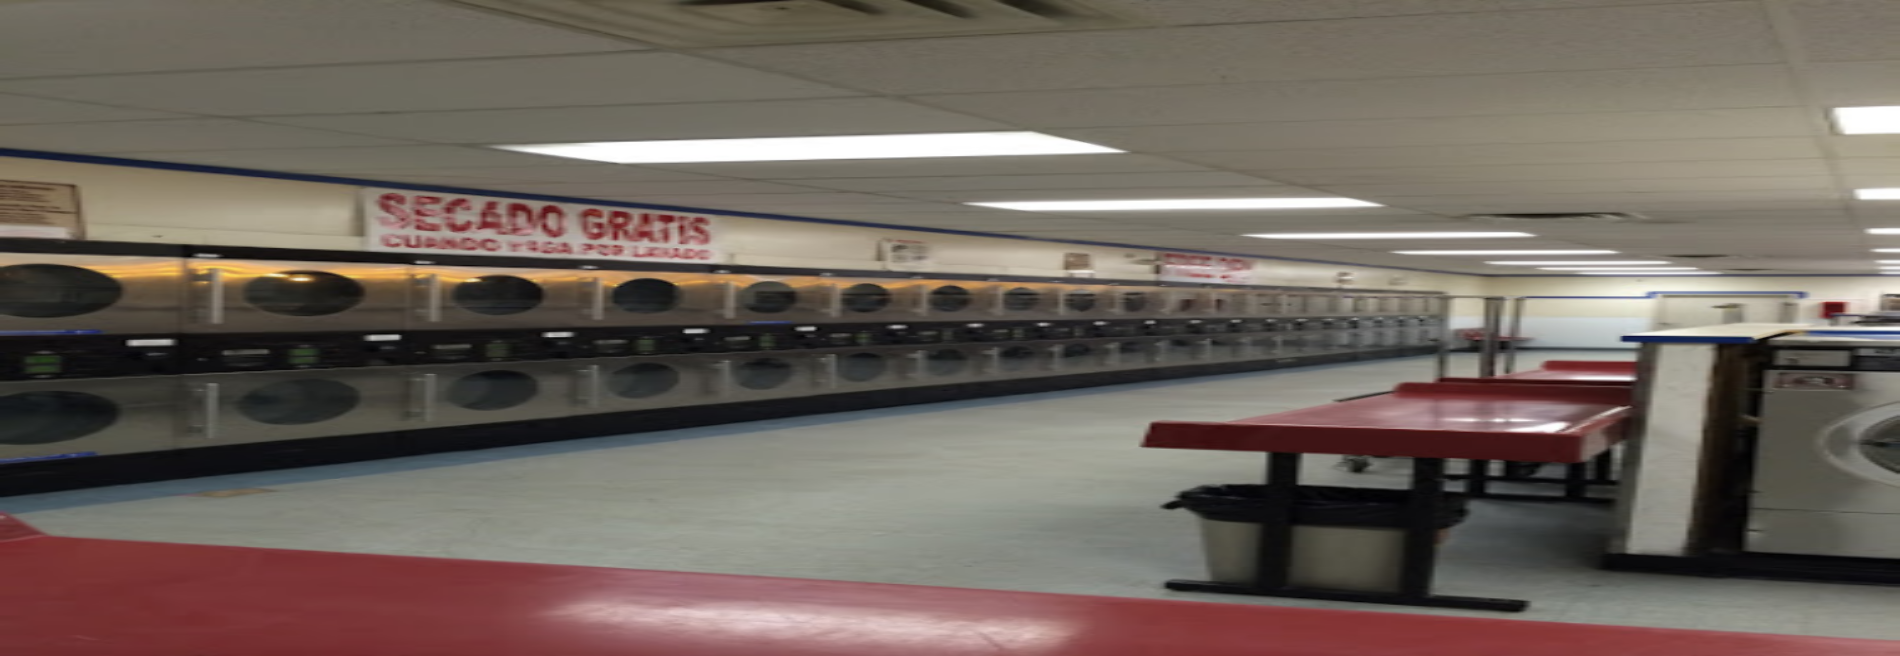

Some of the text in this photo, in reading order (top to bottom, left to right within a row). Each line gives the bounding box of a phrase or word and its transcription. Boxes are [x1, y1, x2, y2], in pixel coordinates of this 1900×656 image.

[376, 192, 712, 245] SECADO GRATIS
[379, 233, 501, 252] CUANDO
